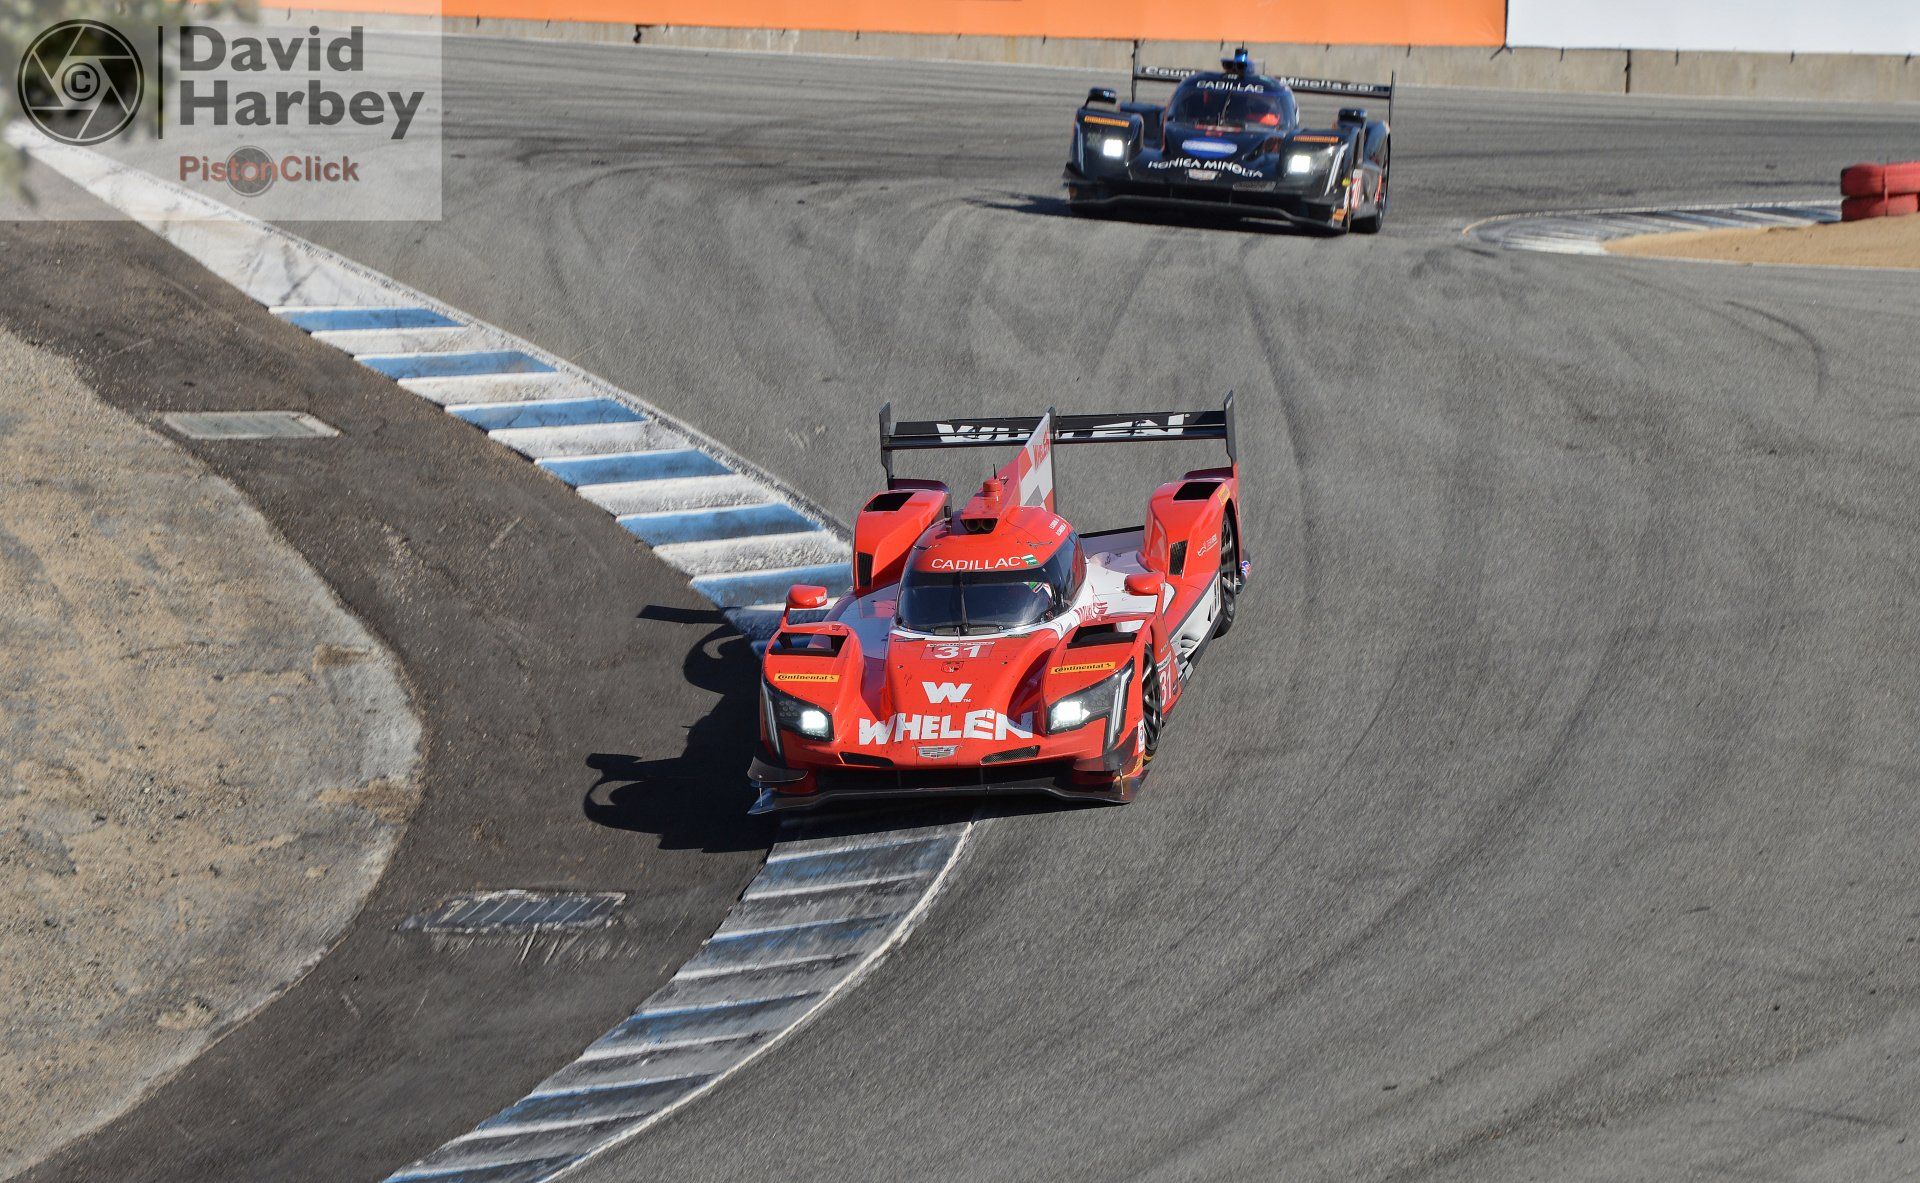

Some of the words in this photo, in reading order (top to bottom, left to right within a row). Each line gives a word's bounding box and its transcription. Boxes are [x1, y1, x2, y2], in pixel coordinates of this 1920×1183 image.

[1196, 80, 1264, 93] CADILLAC
[1148, 157, 1202, 169] KONICA
[1204, 160, 1264, 178] MINOLTA
[931, 556, 1021, 570] CADILLAC
[934, 645, 980, 659] 31
[1054, 663, 1104, 673] Continental
[777, 673, 828, 681] Continental
[859, 708, 1033, 745] WHELEN
